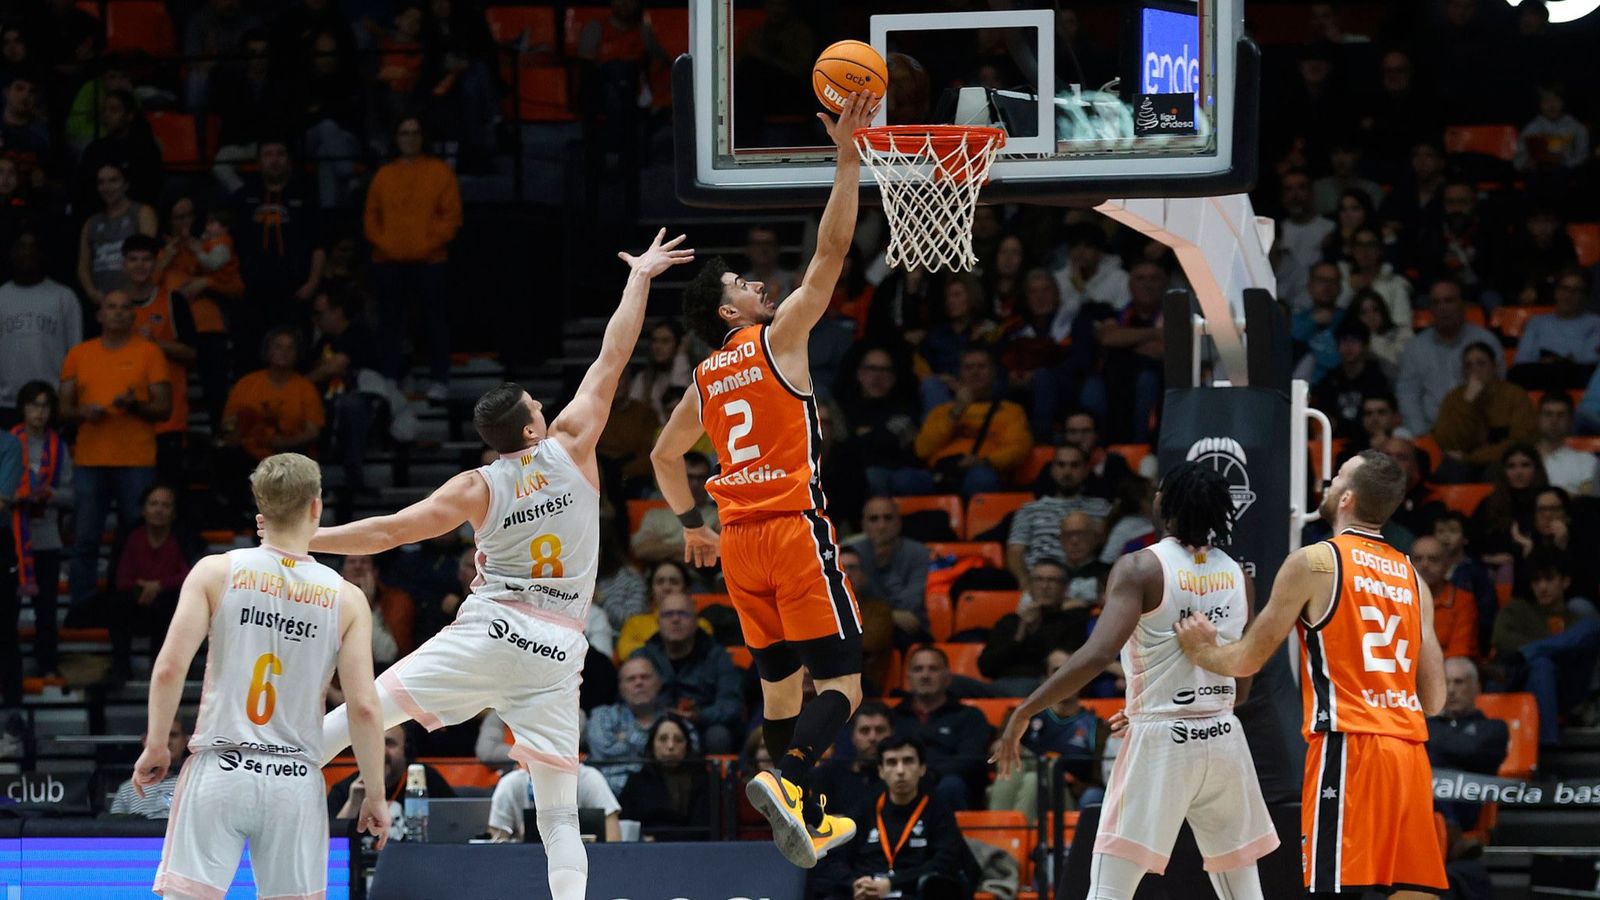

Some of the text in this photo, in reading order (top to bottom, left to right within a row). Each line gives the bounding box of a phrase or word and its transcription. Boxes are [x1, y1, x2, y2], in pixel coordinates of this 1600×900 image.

[845, 72, 866, 87] acb
[1144, 43, 1199, 101] ende
[823, 83, 849, 108] Wil
[1160, 113, 1176, 122] liga
[1160, 120, 1194, 129] endesa
[0, 312, 57, 336] OSTON
[701, 341, 756, 376] PUERTO
[723, 398, 761, 465] 2
[1351, 548, 1408, 579] COSTELLO
[260, 571, 285, 599] DER
[507, 630, 567, 662] serveto
[1359, 605, 1412, 674] 24
[246, 652, 283, 726] 6
[243, 759, 308, 777] serveto
[7, 774, 65, 803] club
[1553, 781, 1600, 804] bas
